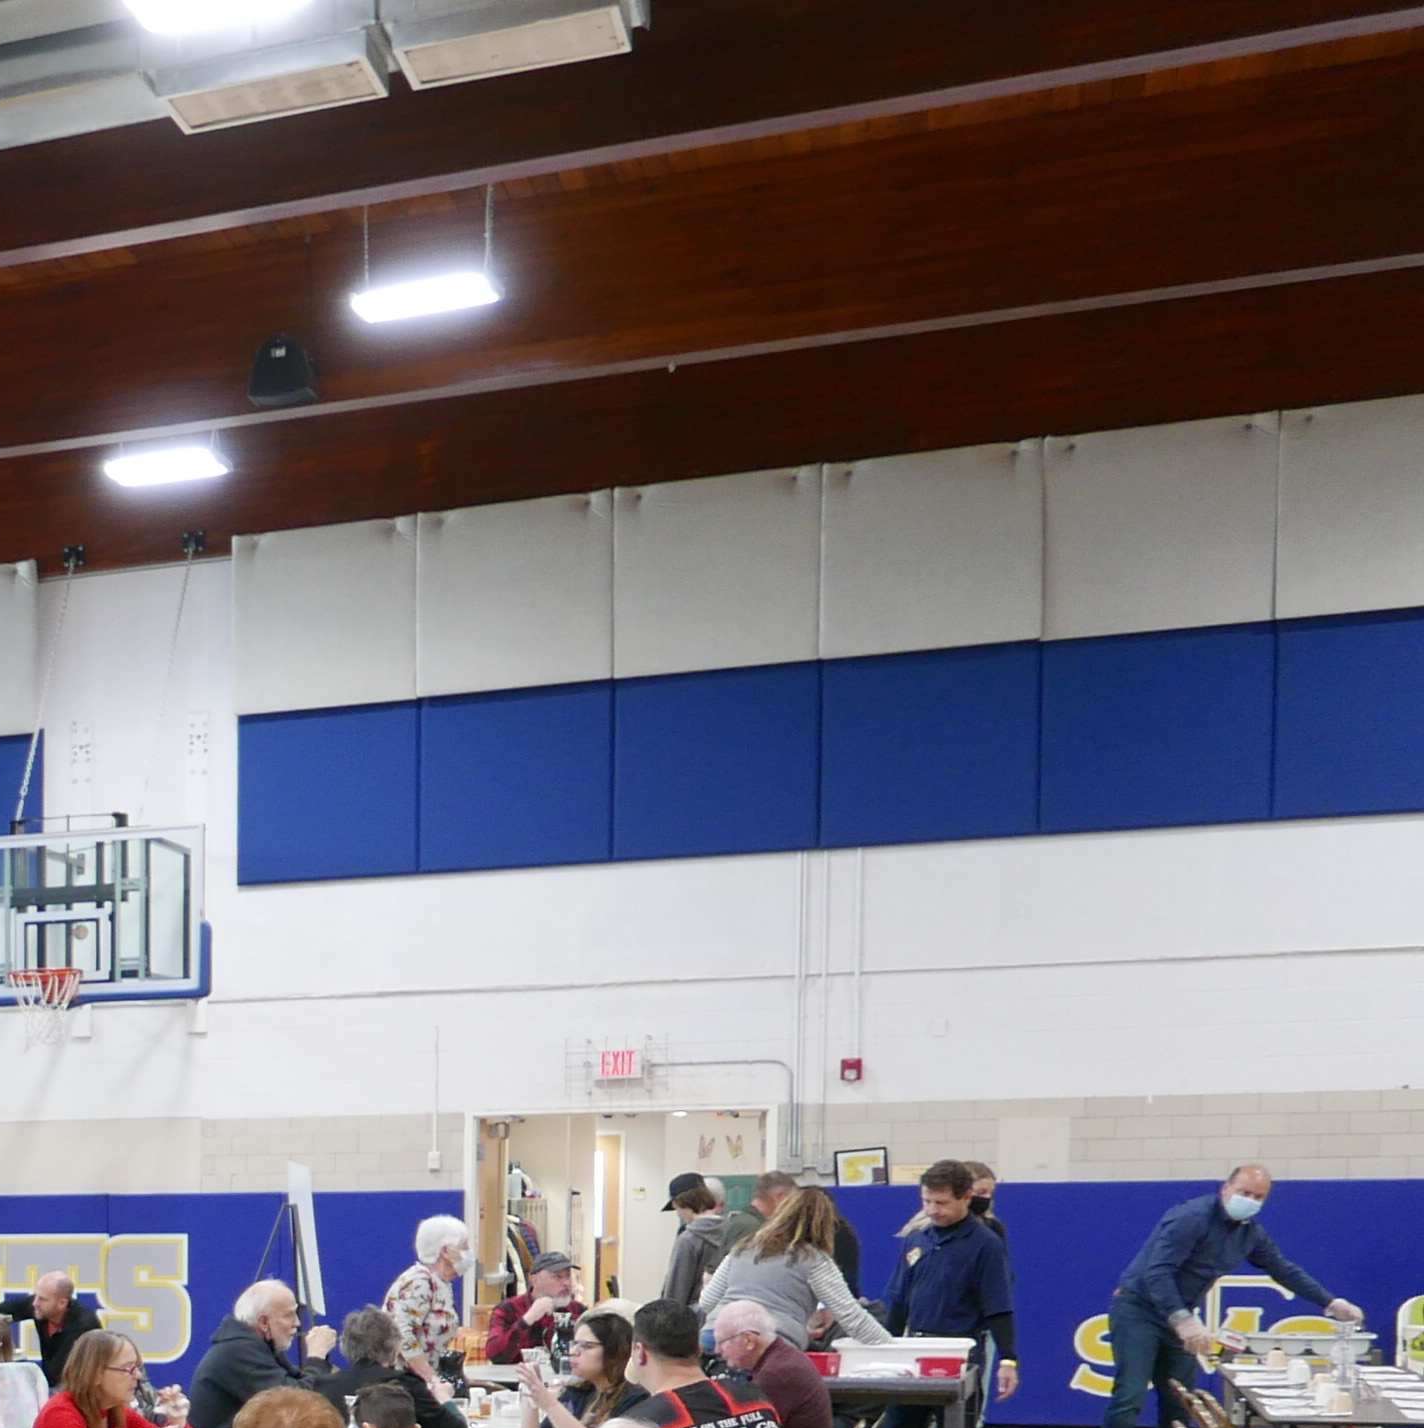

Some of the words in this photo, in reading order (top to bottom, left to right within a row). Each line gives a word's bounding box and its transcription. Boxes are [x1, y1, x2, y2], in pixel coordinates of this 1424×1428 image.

[601, 1050, 635, 1076] EXIT
[717, 1418, 739, 1428] THE
[740, 1411, 764, 1425] FULL
